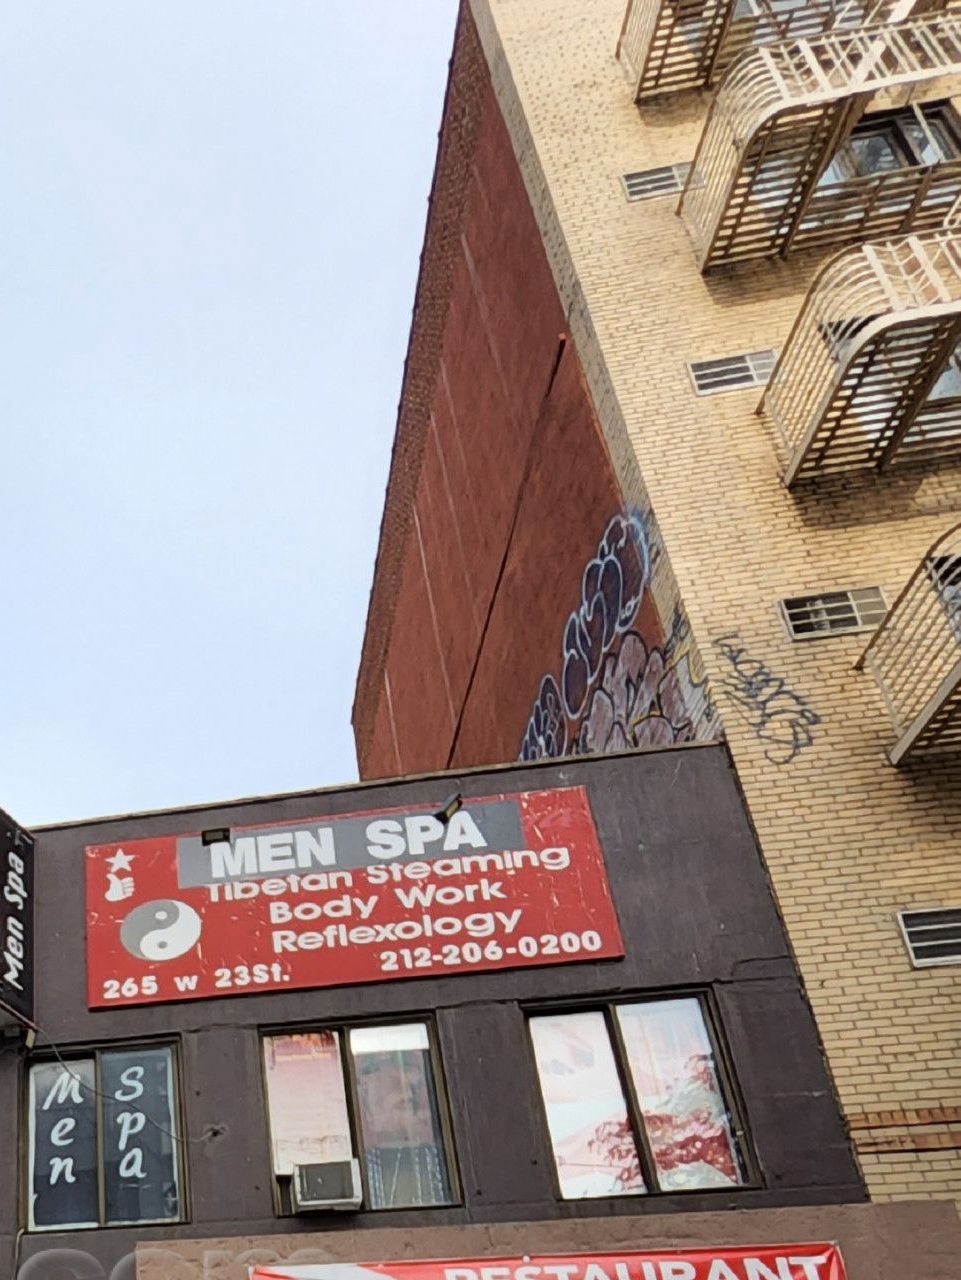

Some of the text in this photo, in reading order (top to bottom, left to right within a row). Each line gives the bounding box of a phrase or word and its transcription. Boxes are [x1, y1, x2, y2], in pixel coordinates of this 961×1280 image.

[210, 811, 487, 878] MEN SPA
[270, 879, 508, 924] Body Work
[272, 909, 522, 953] Reflexology
[380, 931, 602, 971] 212-206-0200
[3, 916, 24, 991] Men
[103, 975, 159, 999] 265
